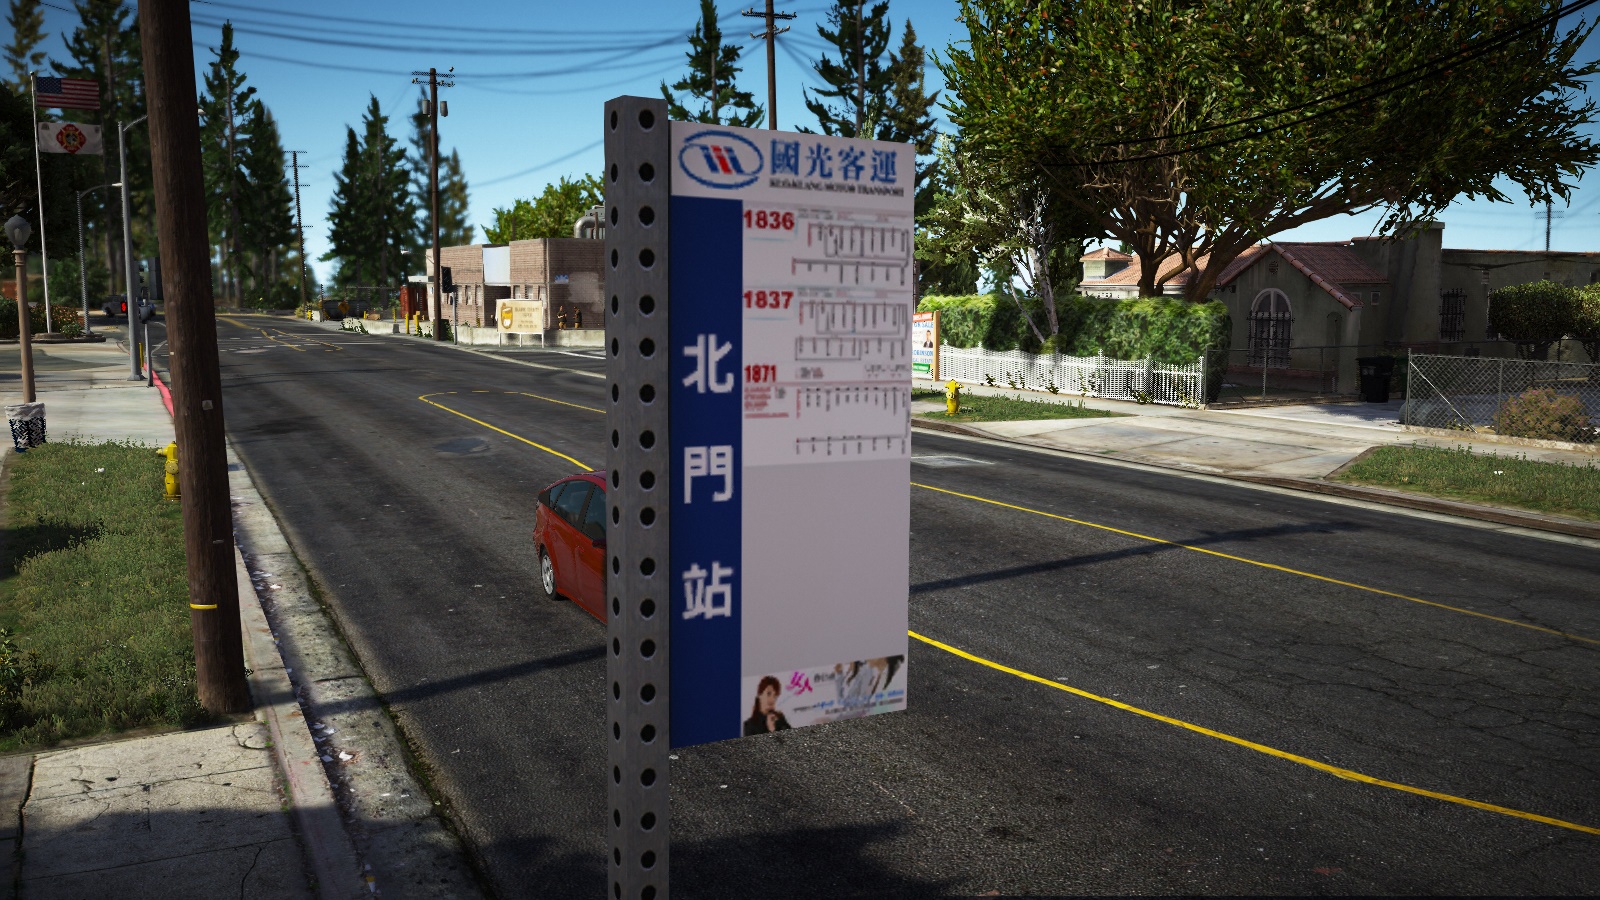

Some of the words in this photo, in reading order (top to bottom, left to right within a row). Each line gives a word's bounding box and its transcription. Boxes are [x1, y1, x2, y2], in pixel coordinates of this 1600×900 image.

[769, 139, 897, 184] 國光客運
[744, 210, 795, 231] 1836
[744, 290, 794, 309] 1837
[744, 365, 776, 383] 1871
[682, 333, 735, 620] 北門站
